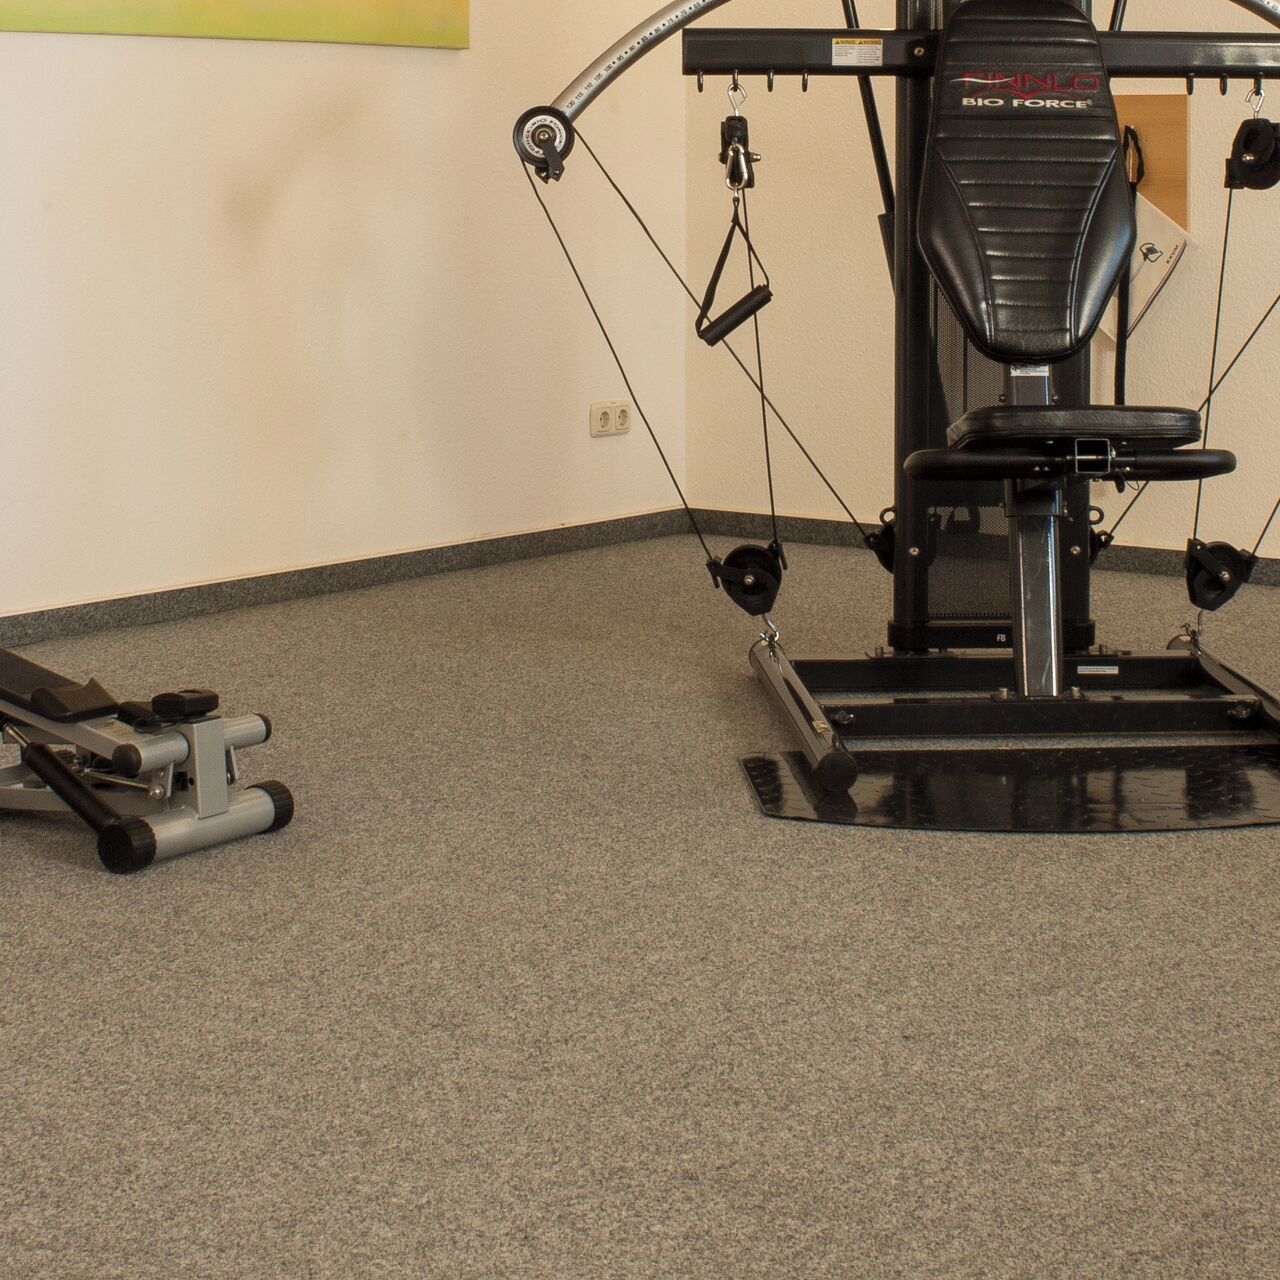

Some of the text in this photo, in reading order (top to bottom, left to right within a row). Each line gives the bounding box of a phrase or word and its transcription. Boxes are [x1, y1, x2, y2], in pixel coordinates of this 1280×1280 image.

[962, 72, 1101, 91] FINNLO
[962, 97, 1089, 109] BIO FORCE
